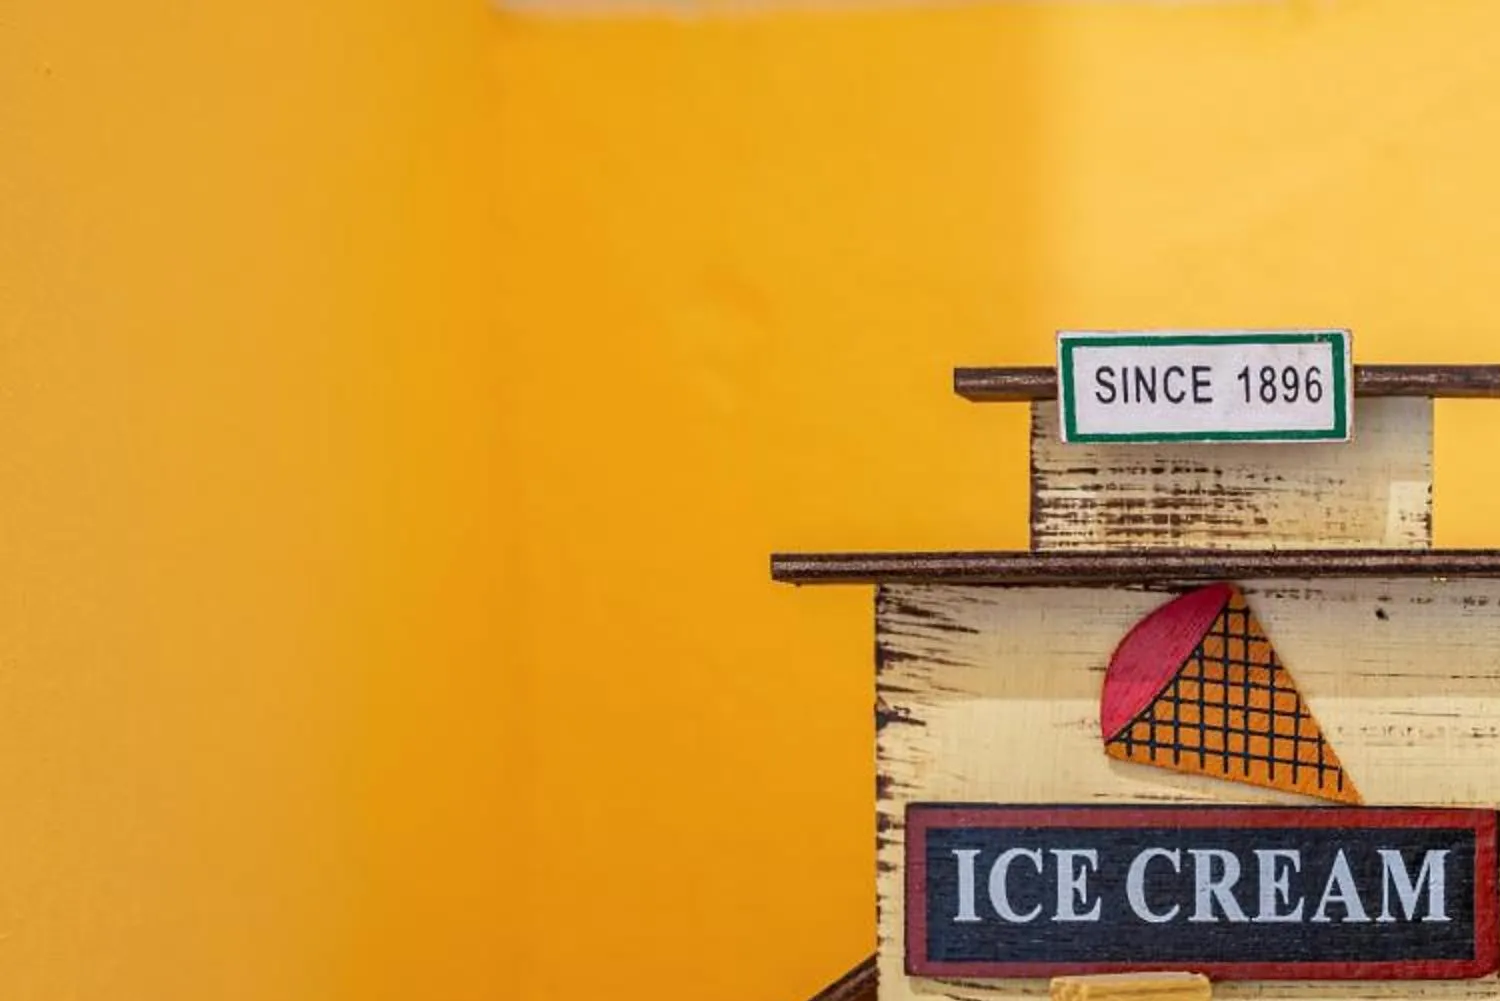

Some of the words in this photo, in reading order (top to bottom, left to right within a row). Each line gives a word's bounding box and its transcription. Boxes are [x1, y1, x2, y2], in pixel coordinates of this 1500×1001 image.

[1095, 365, 1213, 404] SINCE
[1237, 365, 1324, 404] 1896
[951, 847, 1102, 924] ICE
[1125, 847, 1453, 924] CREAM
